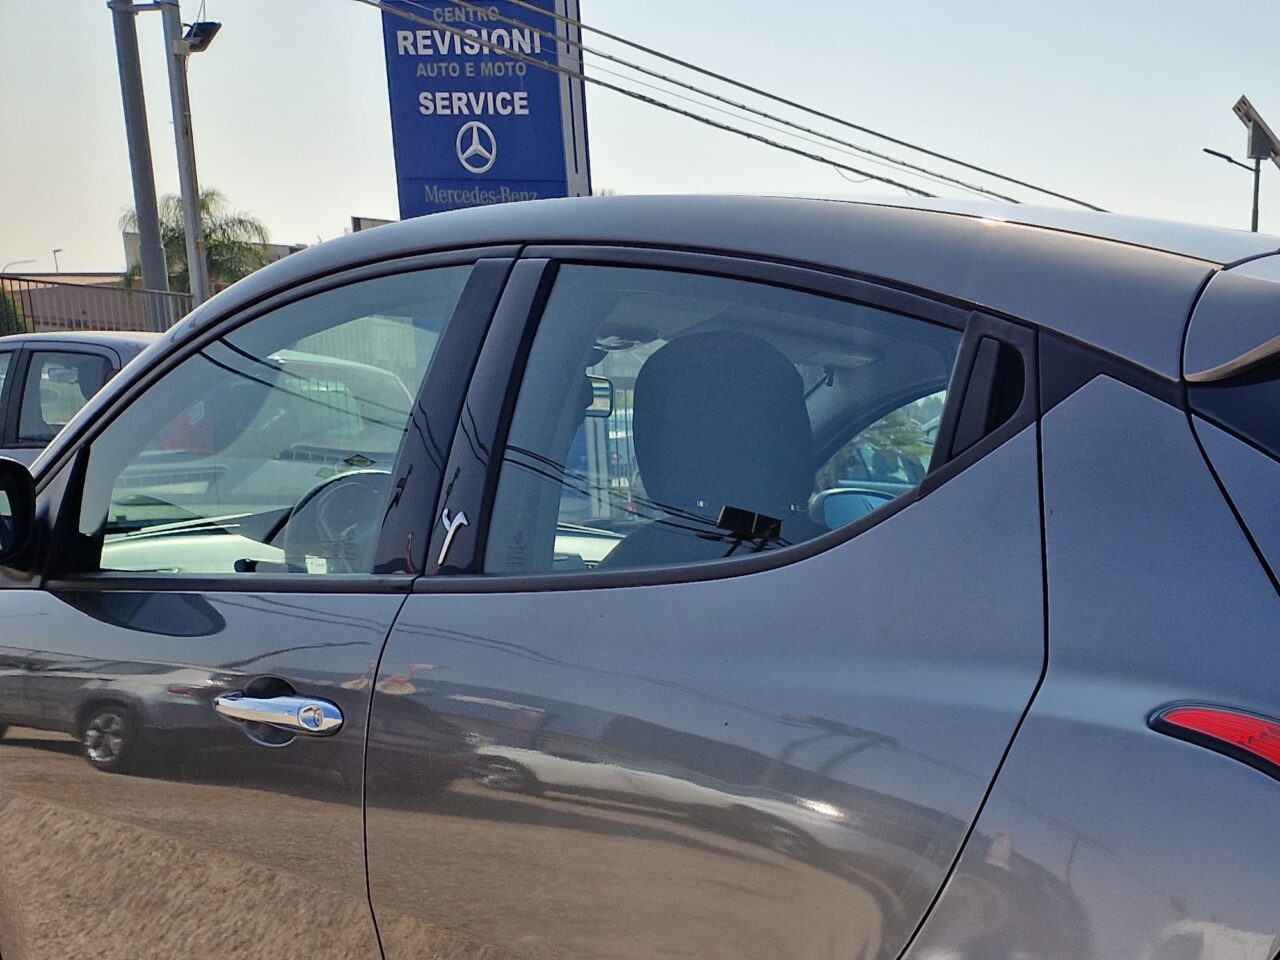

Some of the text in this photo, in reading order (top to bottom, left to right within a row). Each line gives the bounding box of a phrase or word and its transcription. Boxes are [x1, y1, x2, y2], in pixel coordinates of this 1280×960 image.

[433, 6, 499, 23] CENTRO
[397, 29, 541, 56] REVISIONI
[416, 62, 527, 77] AUTO E MOTO
[418, 91, 530, 115] SERVICE
[424, 184, 538, 204] Mercedes-Benz
